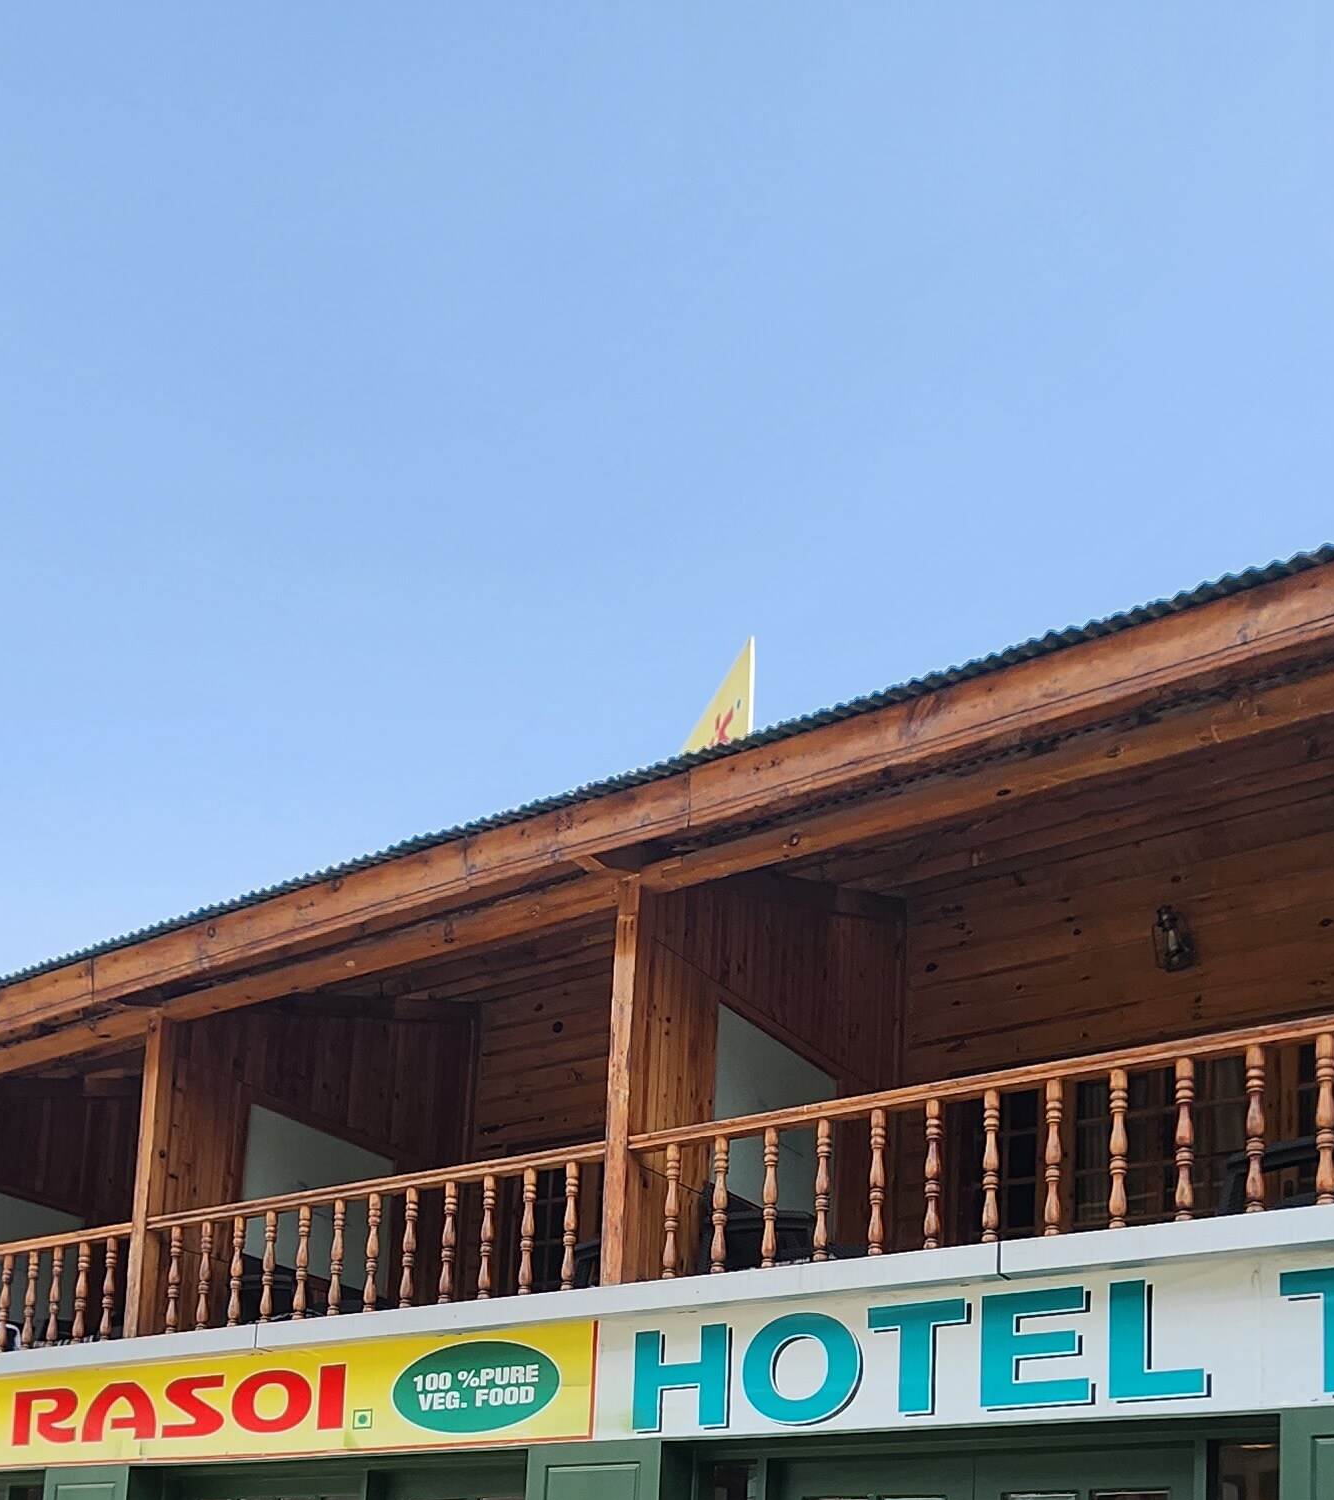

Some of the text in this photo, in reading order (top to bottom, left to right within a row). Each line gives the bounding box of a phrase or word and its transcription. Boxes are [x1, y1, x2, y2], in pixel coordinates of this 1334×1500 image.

[413, 1371, 452, 1392] 100
[632, 1279, 1211, 1433] HOTEL
[11, 1363, 347, 1447] RASOI
[418, 1386, 535, 1411] VEG. FOOD
